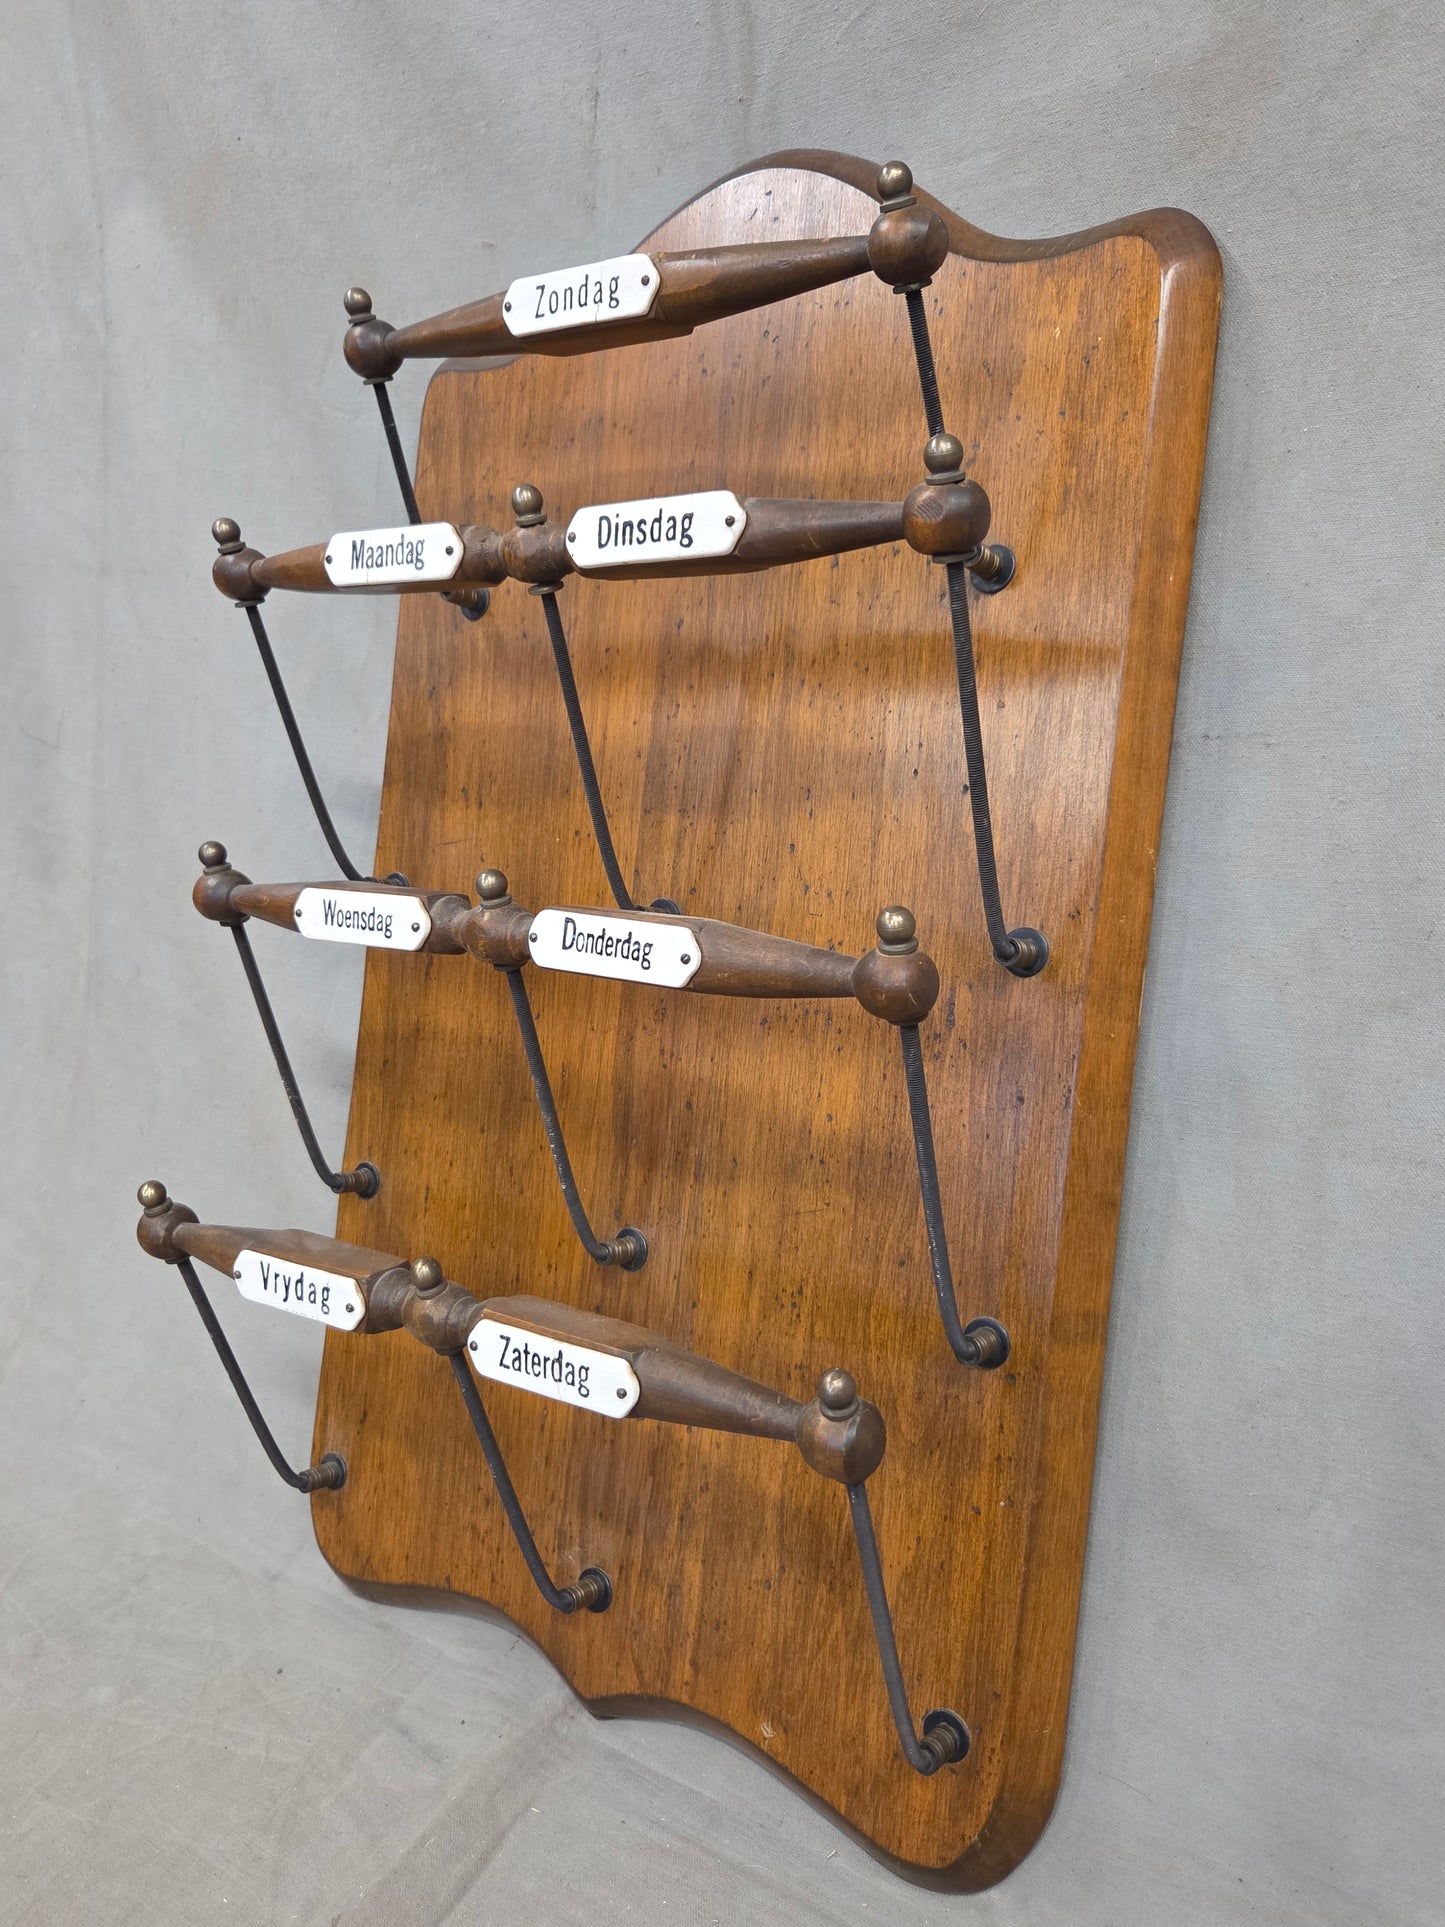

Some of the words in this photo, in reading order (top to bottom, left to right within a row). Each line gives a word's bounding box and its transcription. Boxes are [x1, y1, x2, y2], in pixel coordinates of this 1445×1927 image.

[535, 274, 620, 319] Zondag
[597, 508, 694, 549] Dinsdag
[350, 534, 425, 571] Maandag
[322, 899, 394, 939] Woensdag
[561, 916, 654, 971] Donderdag
[260, 1261, 331, 1315] Vrydag
[498, 1334, 590, 1398] Zaterdag
